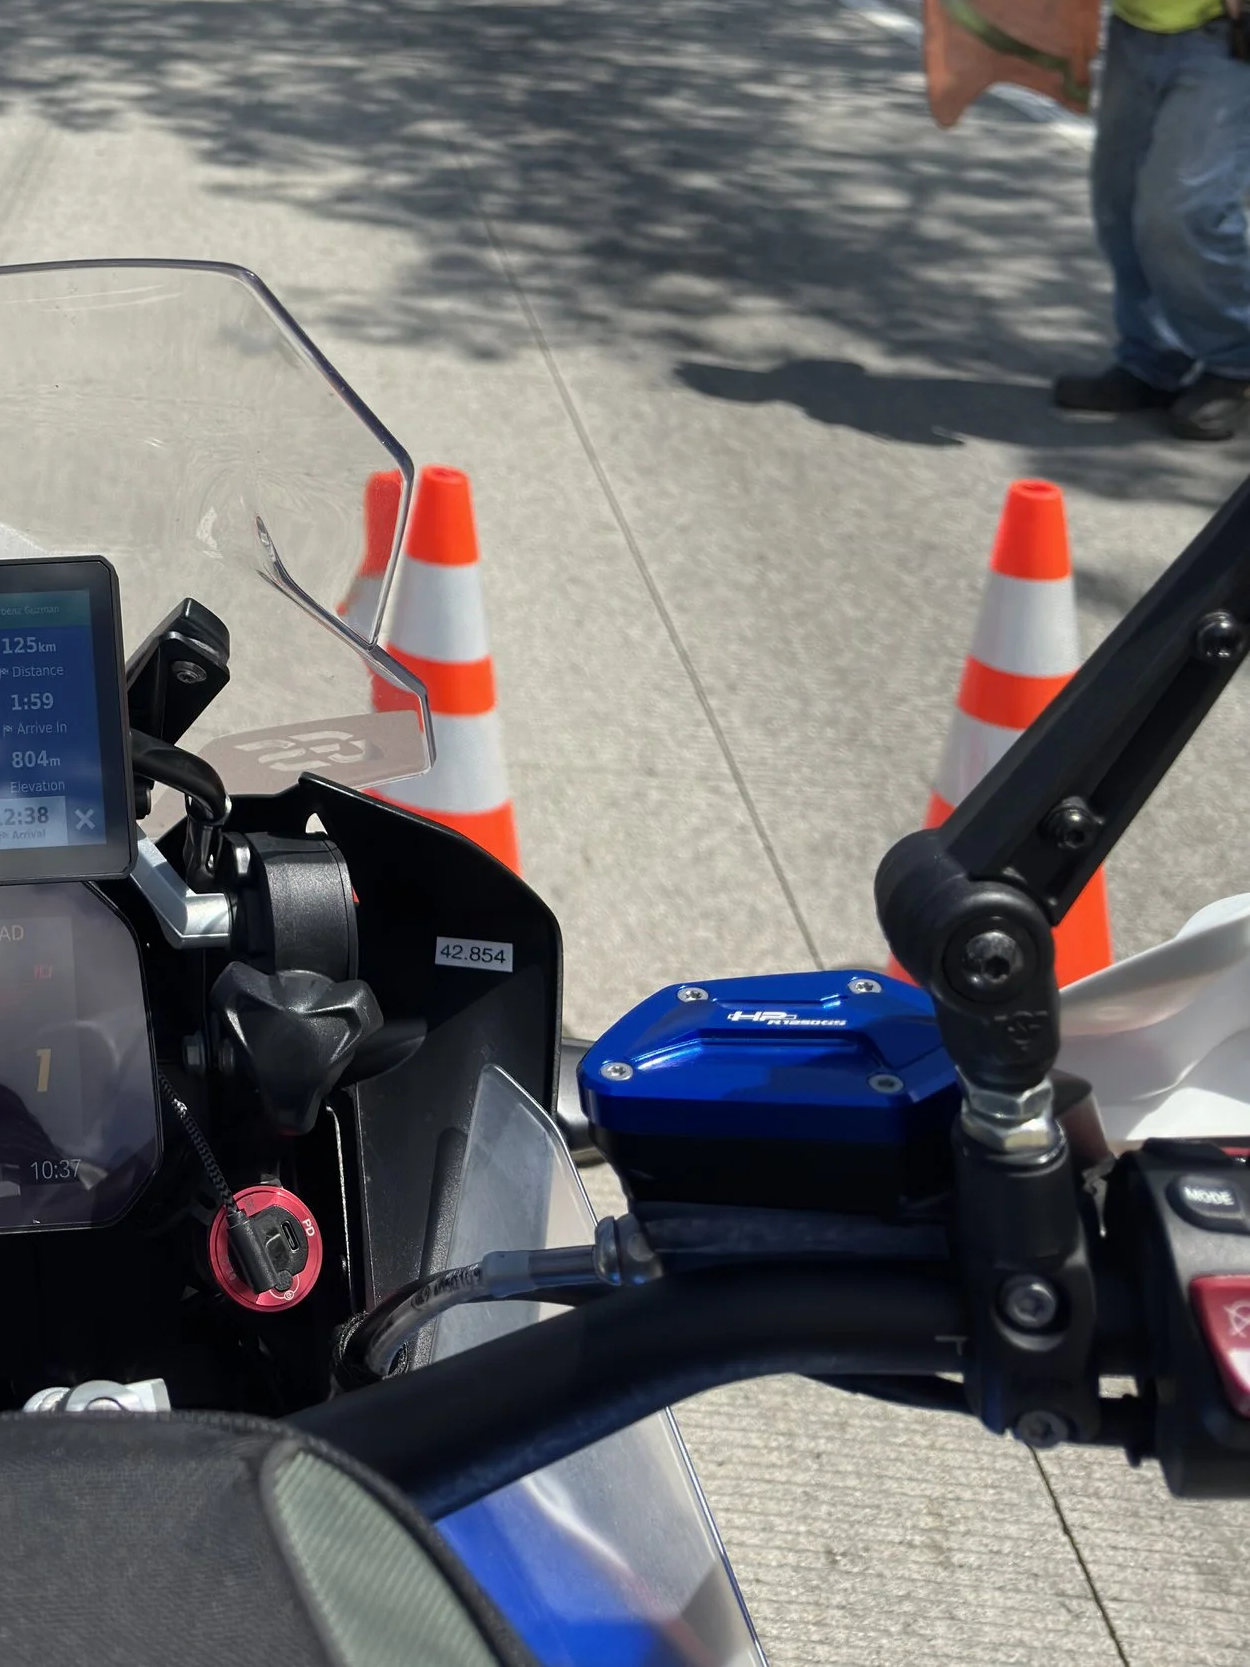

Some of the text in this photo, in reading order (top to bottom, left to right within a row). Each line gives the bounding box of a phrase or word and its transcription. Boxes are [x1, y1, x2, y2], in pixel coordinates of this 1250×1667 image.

[12, 665, 64, 678] Distance
[10, 692, 54, 711] 1:59
[17, 721, 68, 735] Arrive In
[10, 780, 66, 794] Elevation
[11, 828, 46, 840] Arrival
[439, 944, 507, 964] 42.854
[35, 1048, 52, 1093] 1
[29, 1158, 82, 1180] 10:37
[1183, 1186, 1235, 1206] MODE
[301, 1218, 316, 1237] PD
